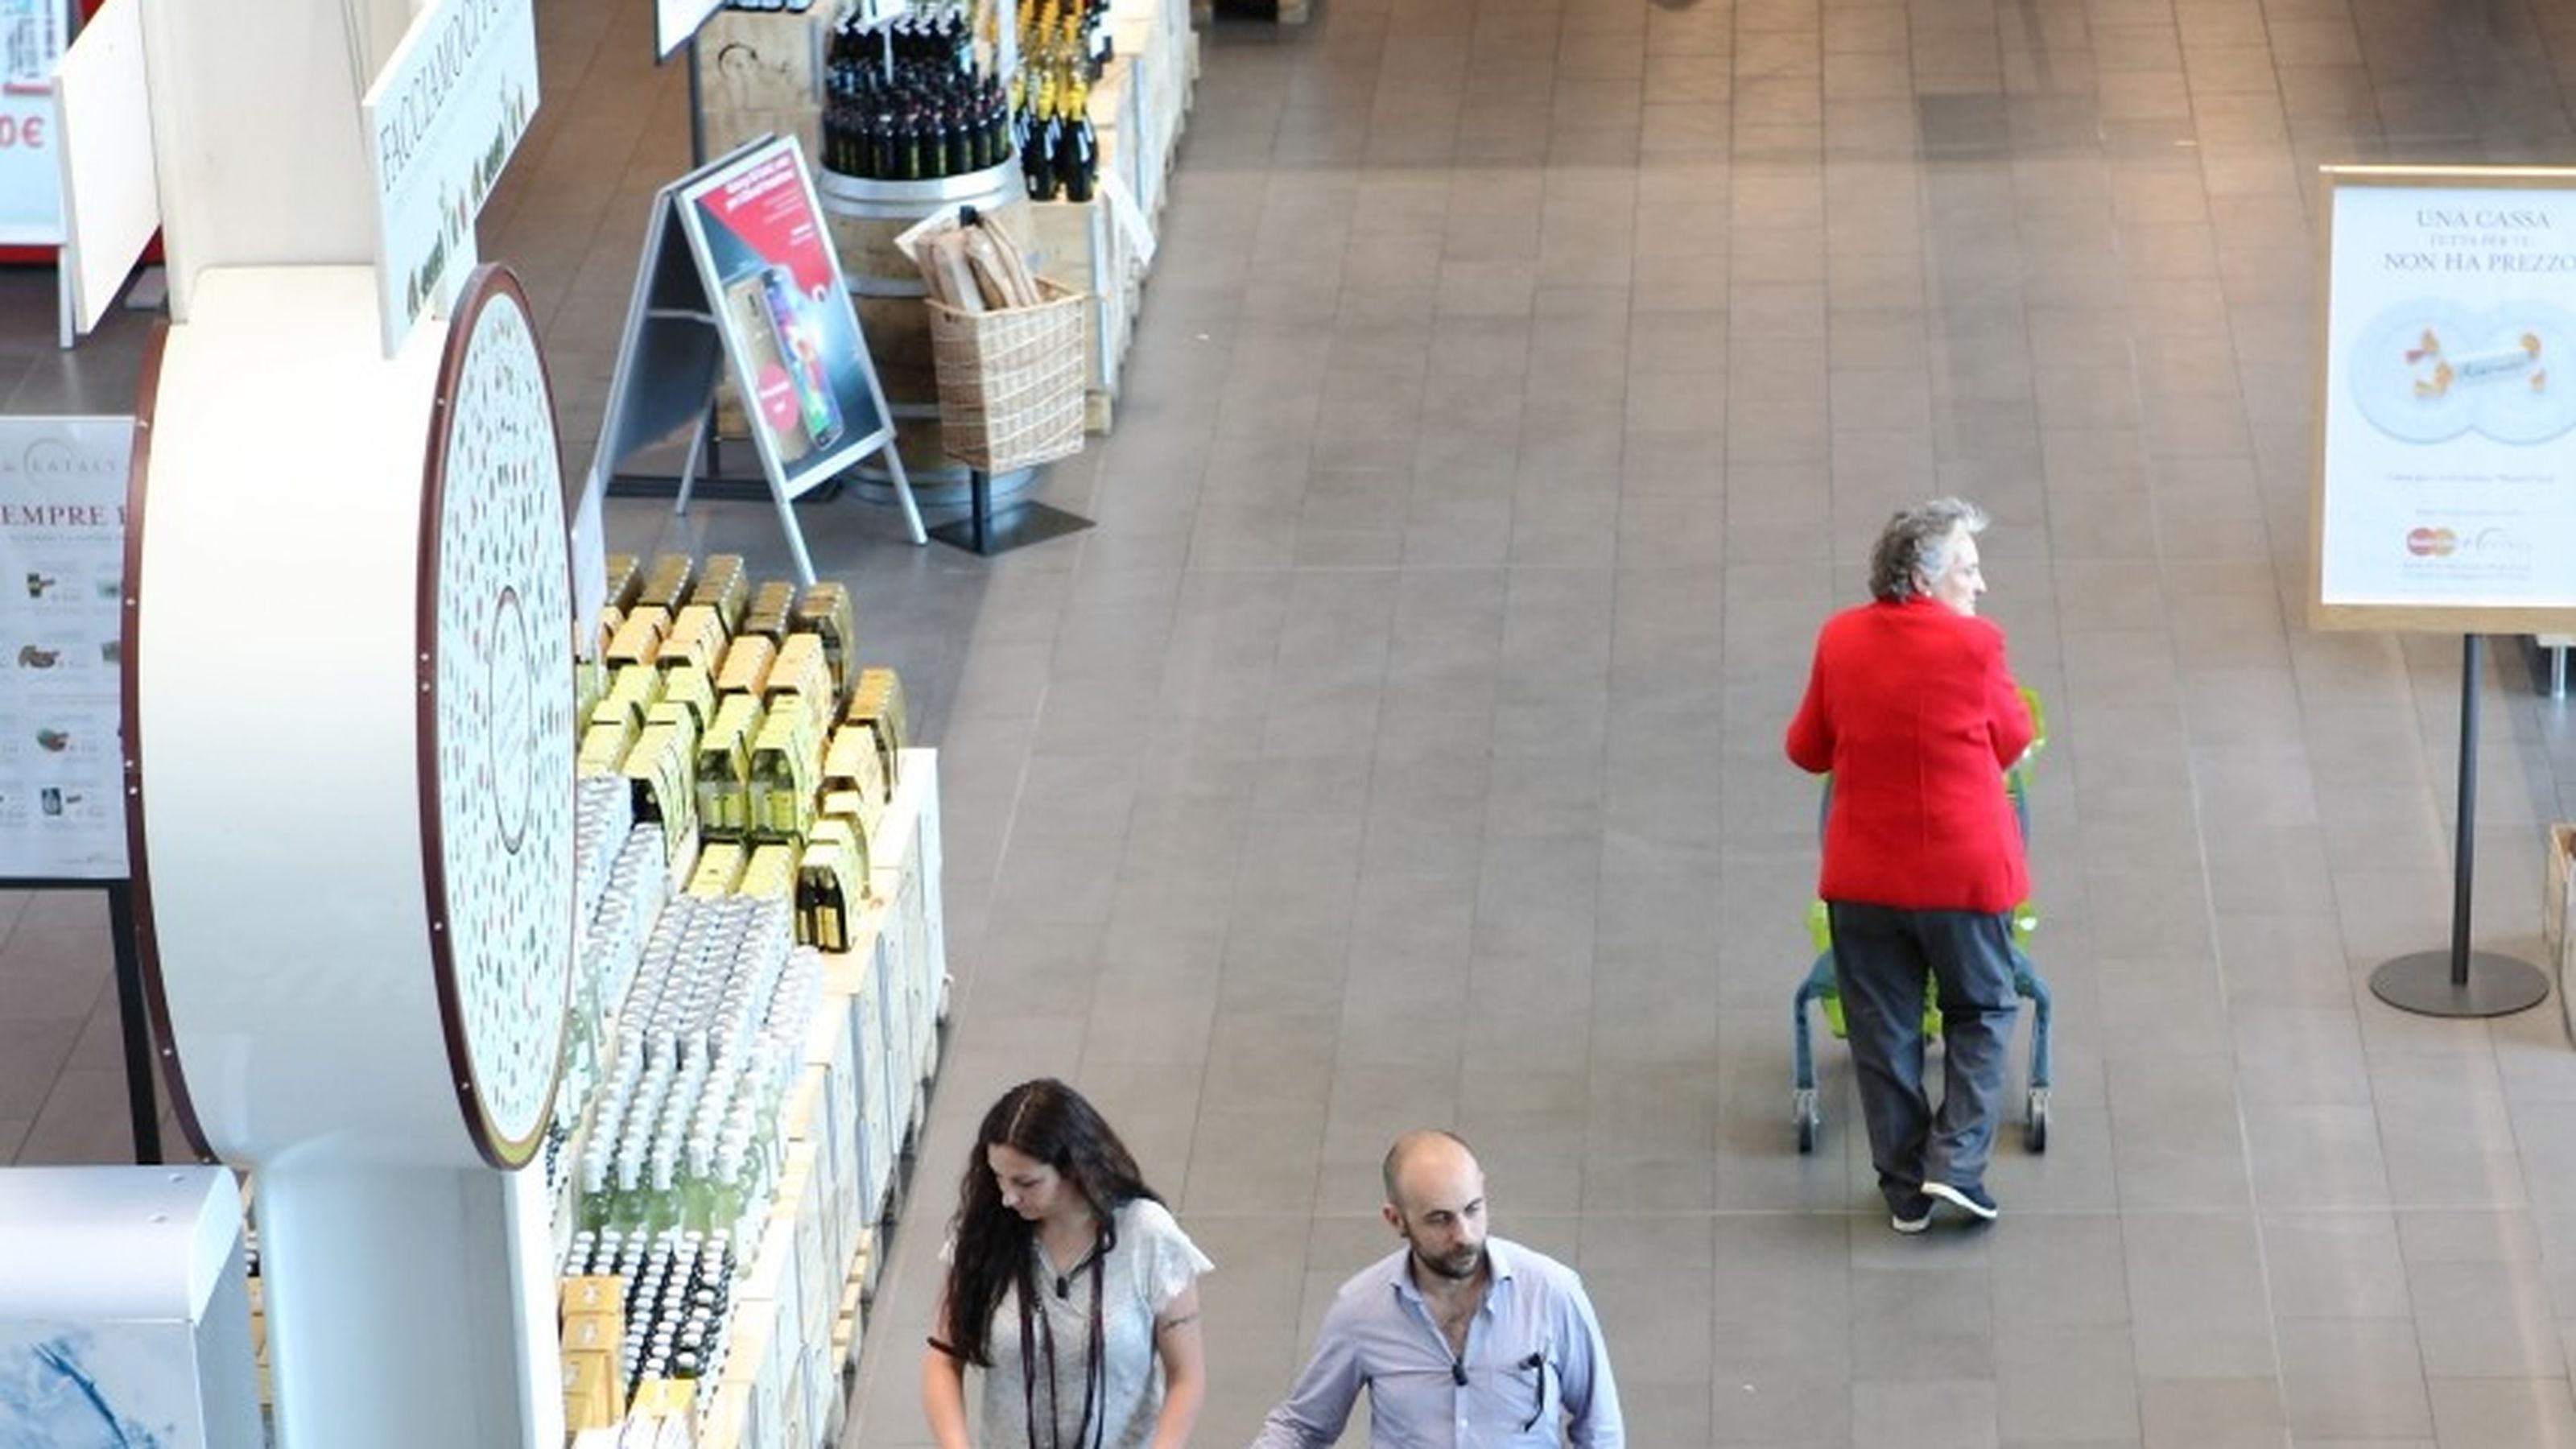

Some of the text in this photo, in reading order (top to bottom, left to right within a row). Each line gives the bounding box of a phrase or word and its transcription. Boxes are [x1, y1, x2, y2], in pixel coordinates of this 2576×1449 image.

[2417, 209, 2551, 229] UNA CASSA
[2384, 252, 2576, 272] NON HA PREZZO
